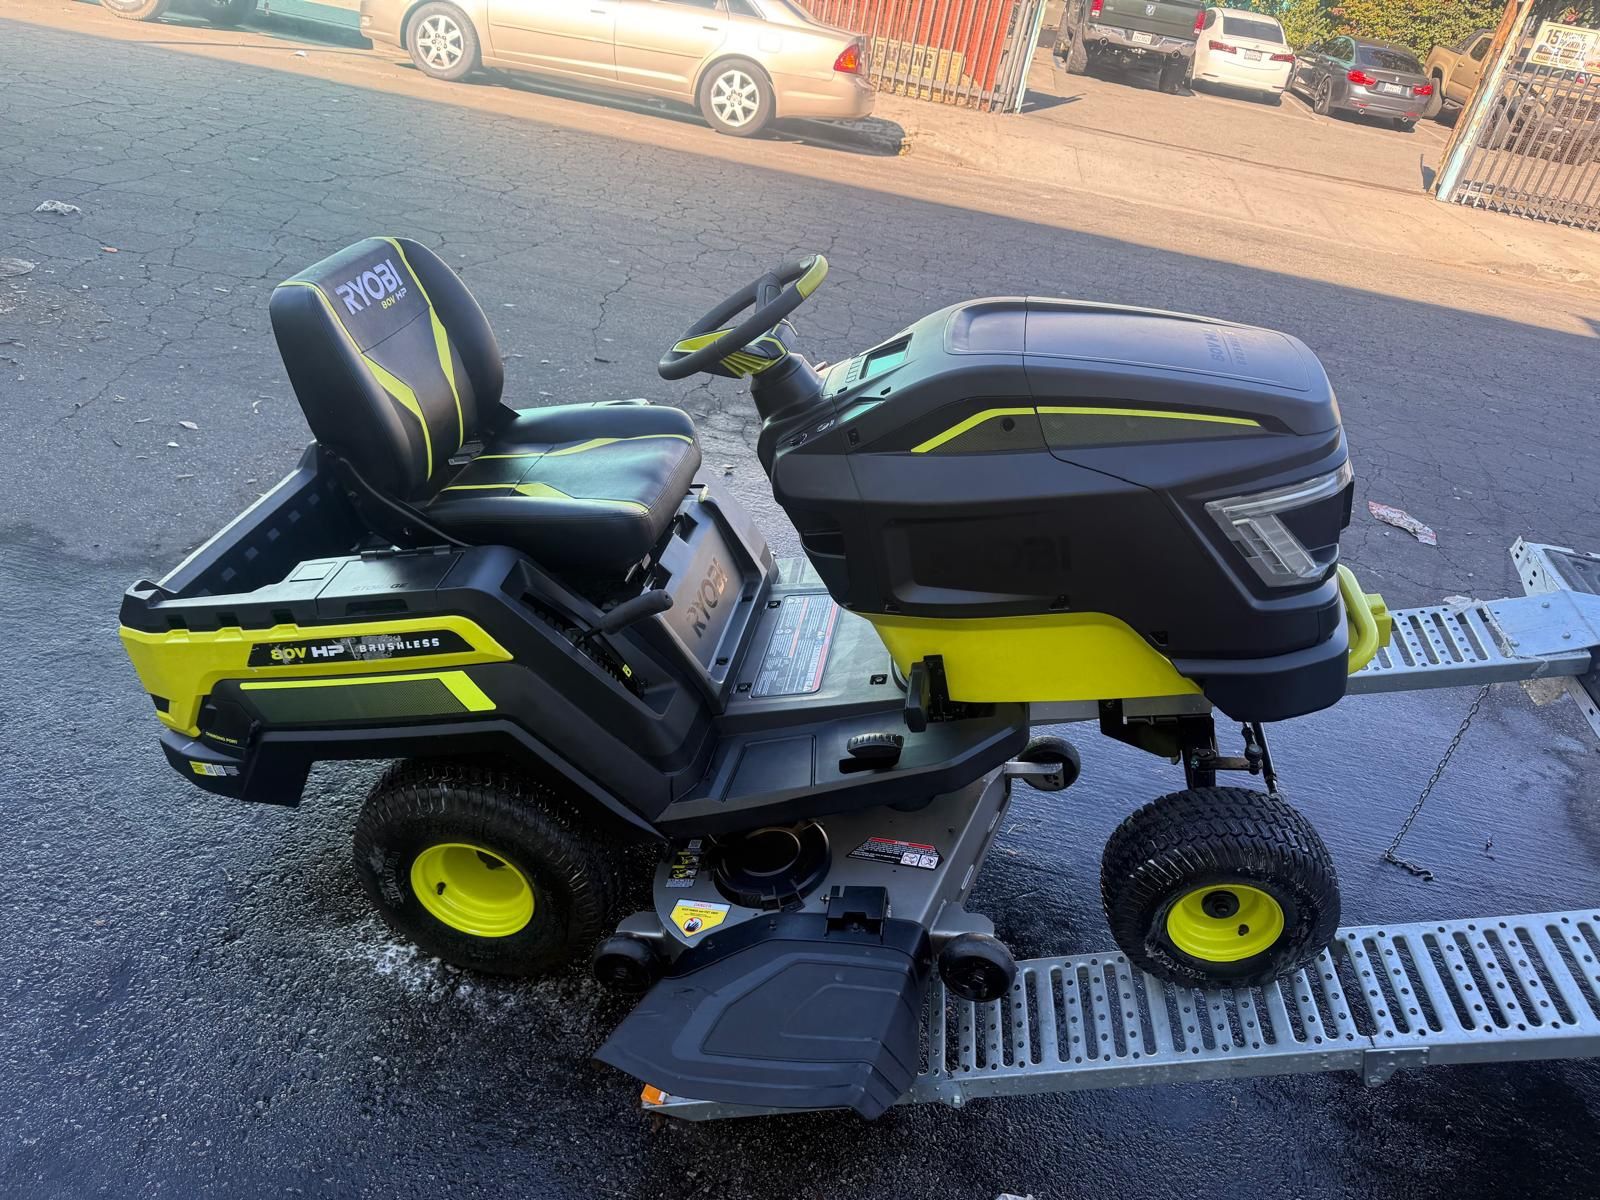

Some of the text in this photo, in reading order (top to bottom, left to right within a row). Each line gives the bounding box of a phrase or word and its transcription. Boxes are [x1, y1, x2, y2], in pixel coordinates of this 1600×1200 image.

[1545, 28, 1562, 45] 15
[875, 43, 934, 69] PRKNG
[334, 258, 403, 315] RYOBI
[381, 287, 407, 309] 80V HP
[686, 556, 728, 639] RYOBI
[271, 637, 440, 660] 80V HP BRUSHLESS
